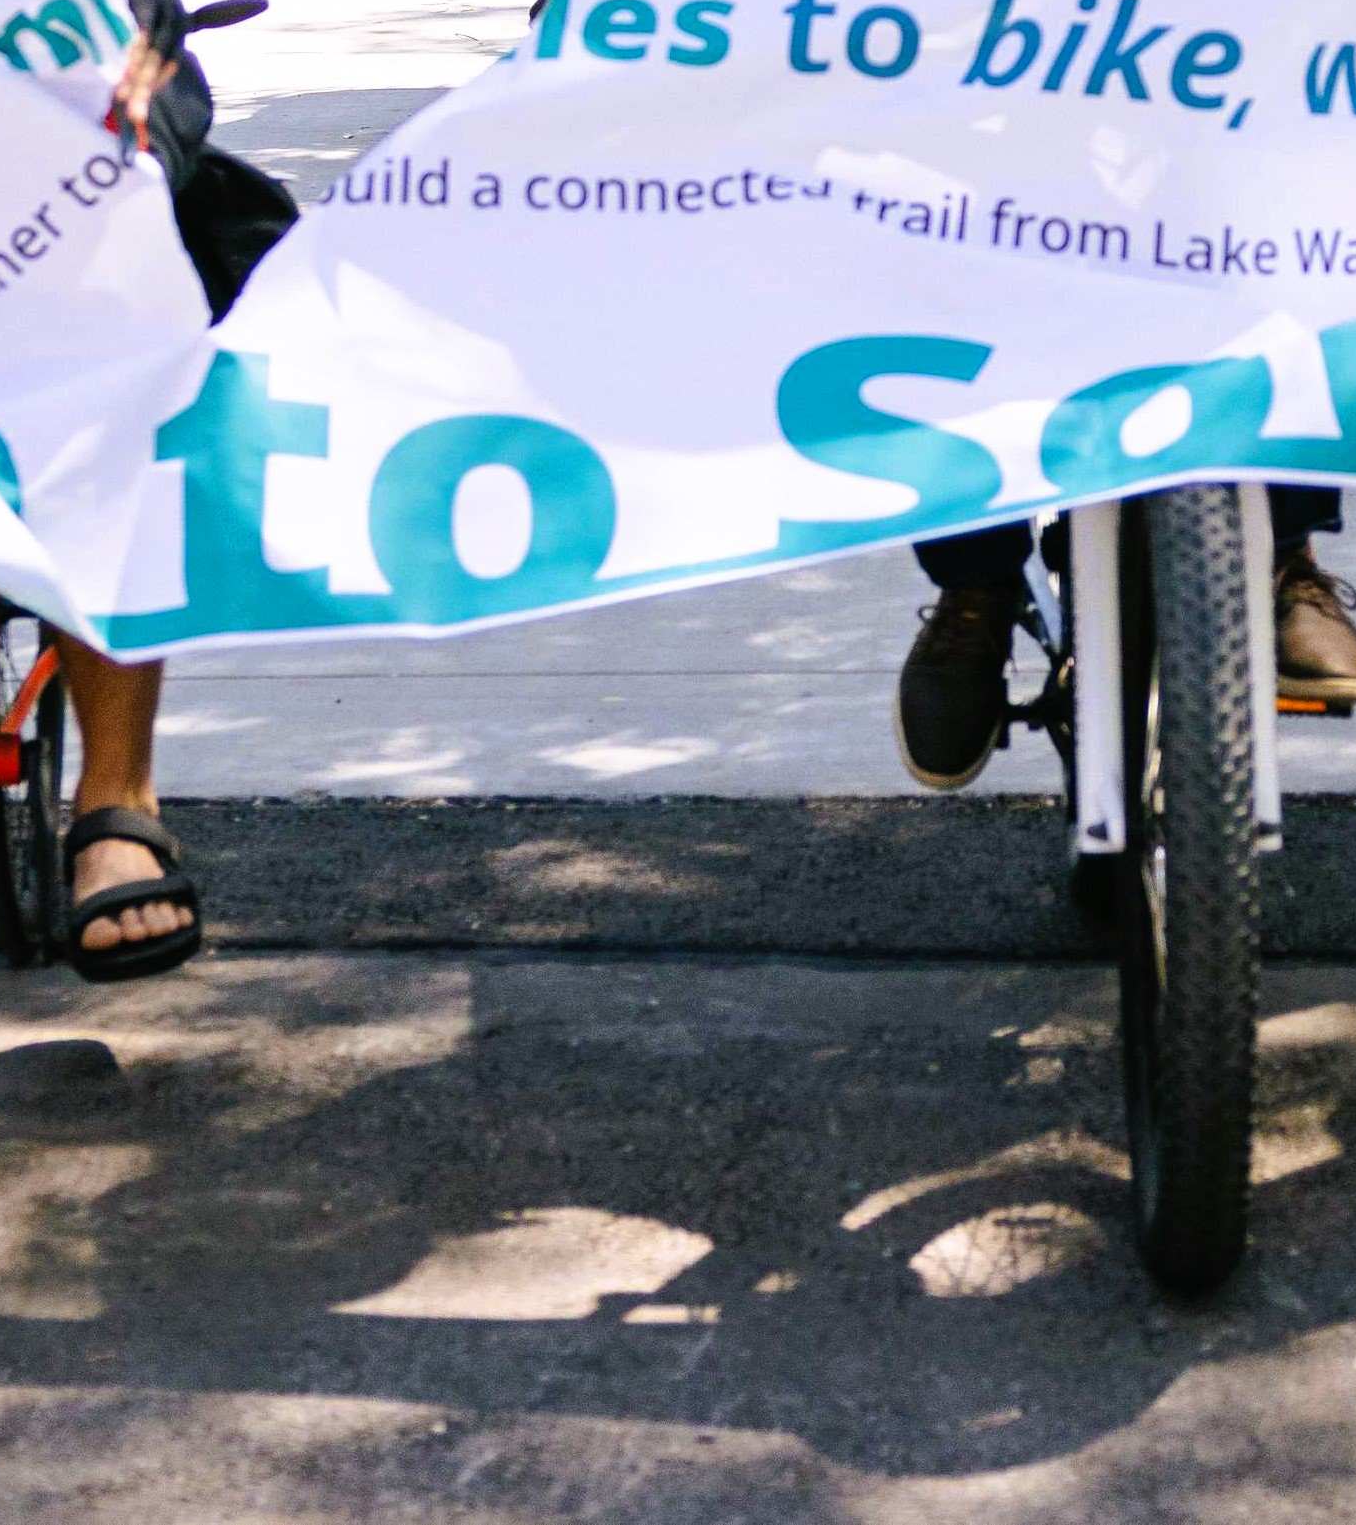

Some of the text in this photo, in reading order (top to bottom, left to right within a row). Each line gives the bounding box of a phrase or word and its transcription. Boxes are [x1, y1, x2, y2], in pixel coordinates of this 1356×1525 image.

[470, 172, 503, 209] a
[990, 196, 1130, 262] from
[1154, 220, 1279, 276] Lake
[153, 350, 618, 621] to
